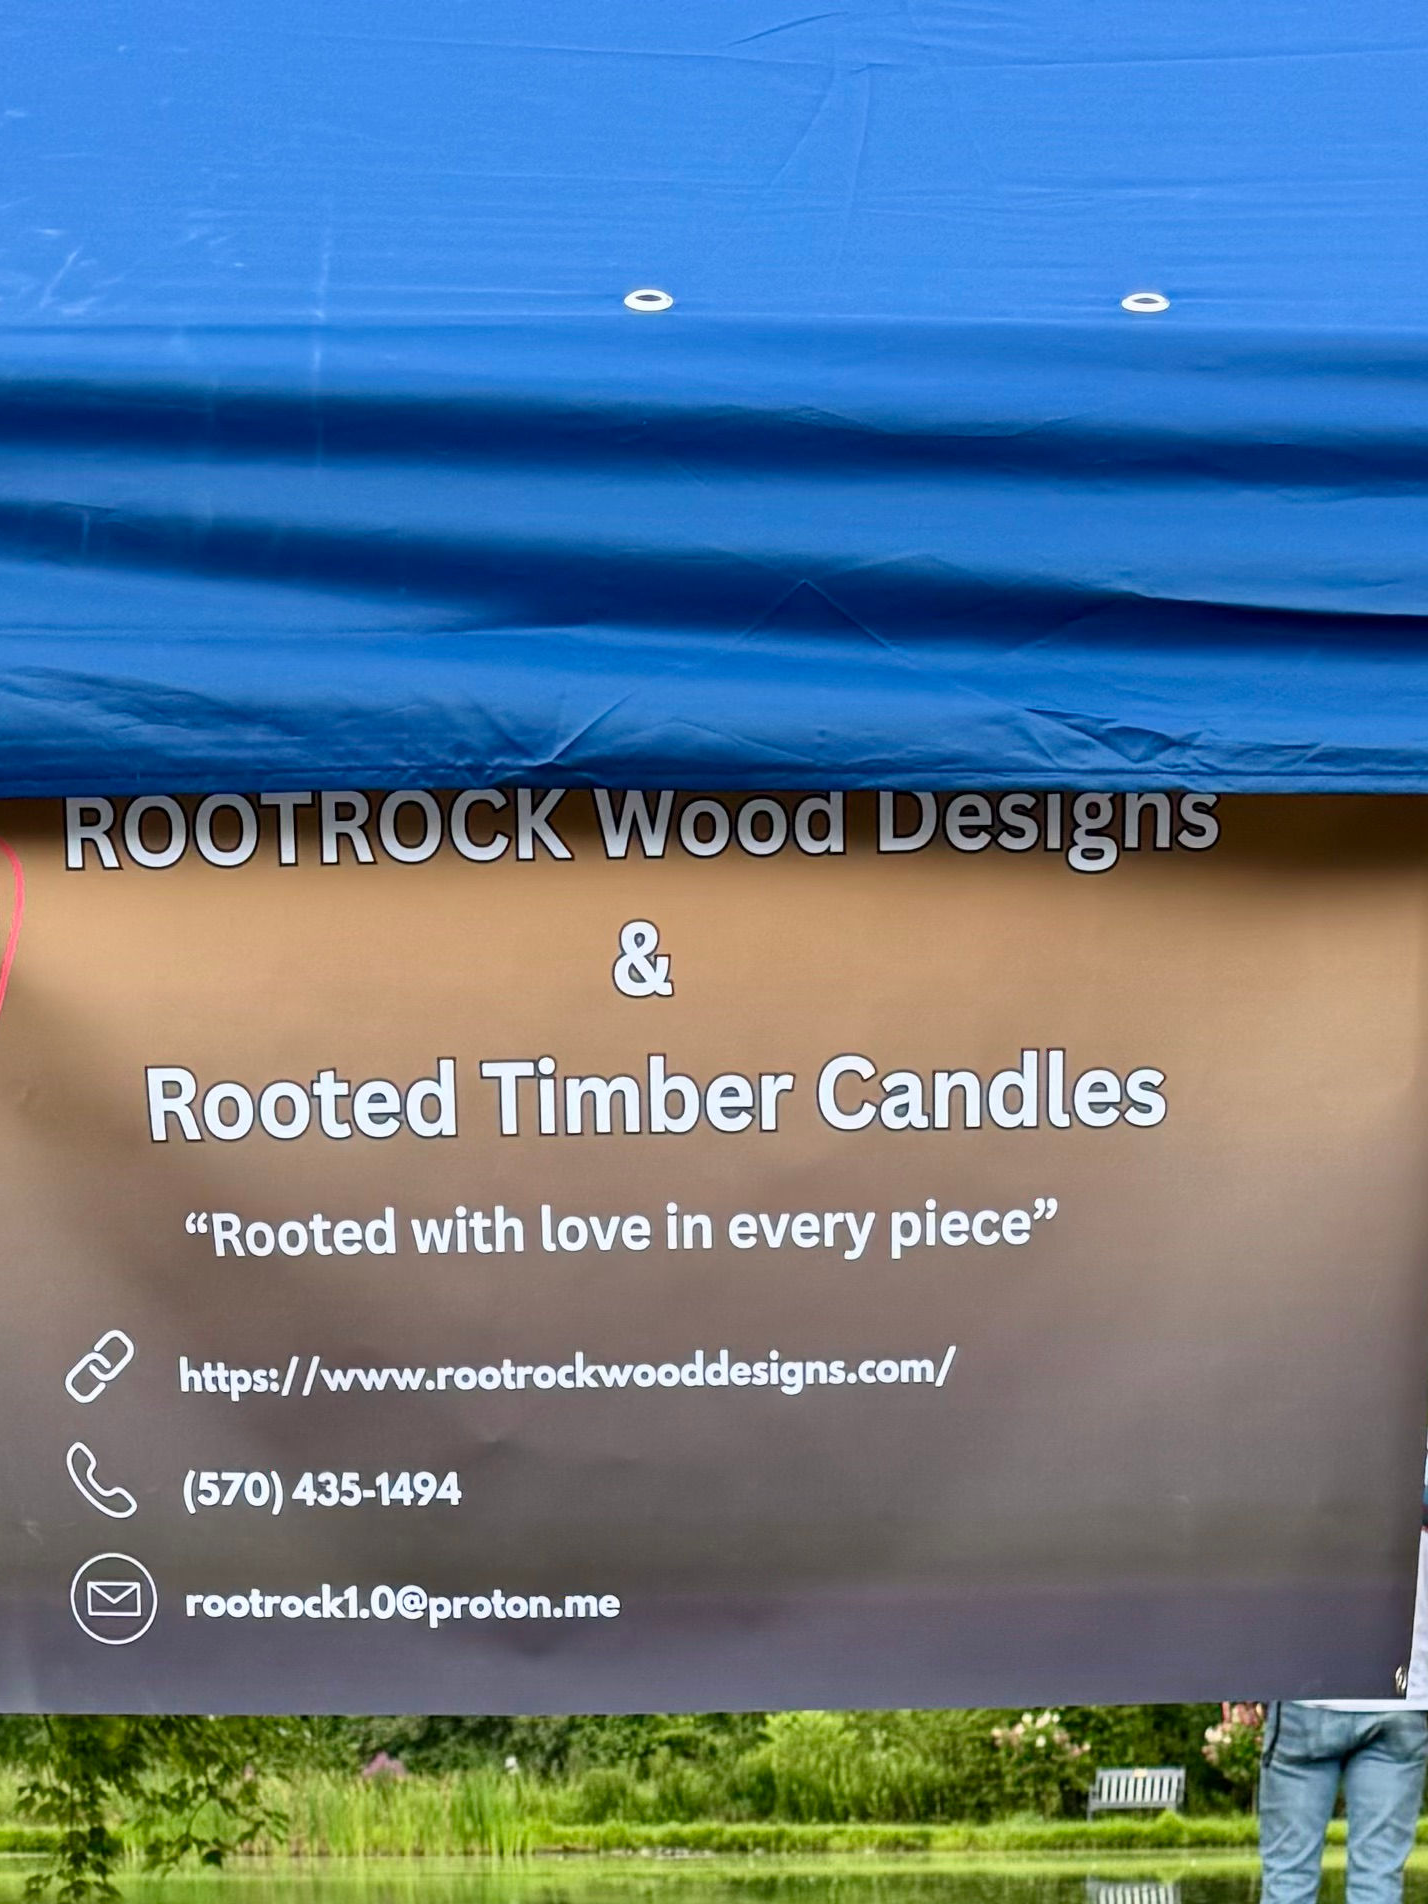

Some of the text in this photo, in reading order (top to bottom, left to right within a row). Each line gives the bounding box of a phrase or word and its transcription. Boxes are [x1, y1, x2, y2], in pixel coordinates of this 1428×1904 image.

[64, 789, 1222, 873] ROOTROCK Wood Designs
[612, 919, 674, 1000] &
[143, 1049, 1169, 1143] Rooted Timber Candles
[184, 1197, 1059, 1262] “Rooted with love in every piece”
[178, 1345, 957, 1402] https://www.rootrockwooddesigns.com/
[182, 1470, 463, 1516] (570) 435-1494
[184, 1584, 621, 1629] rootrock1.0@proton.me
